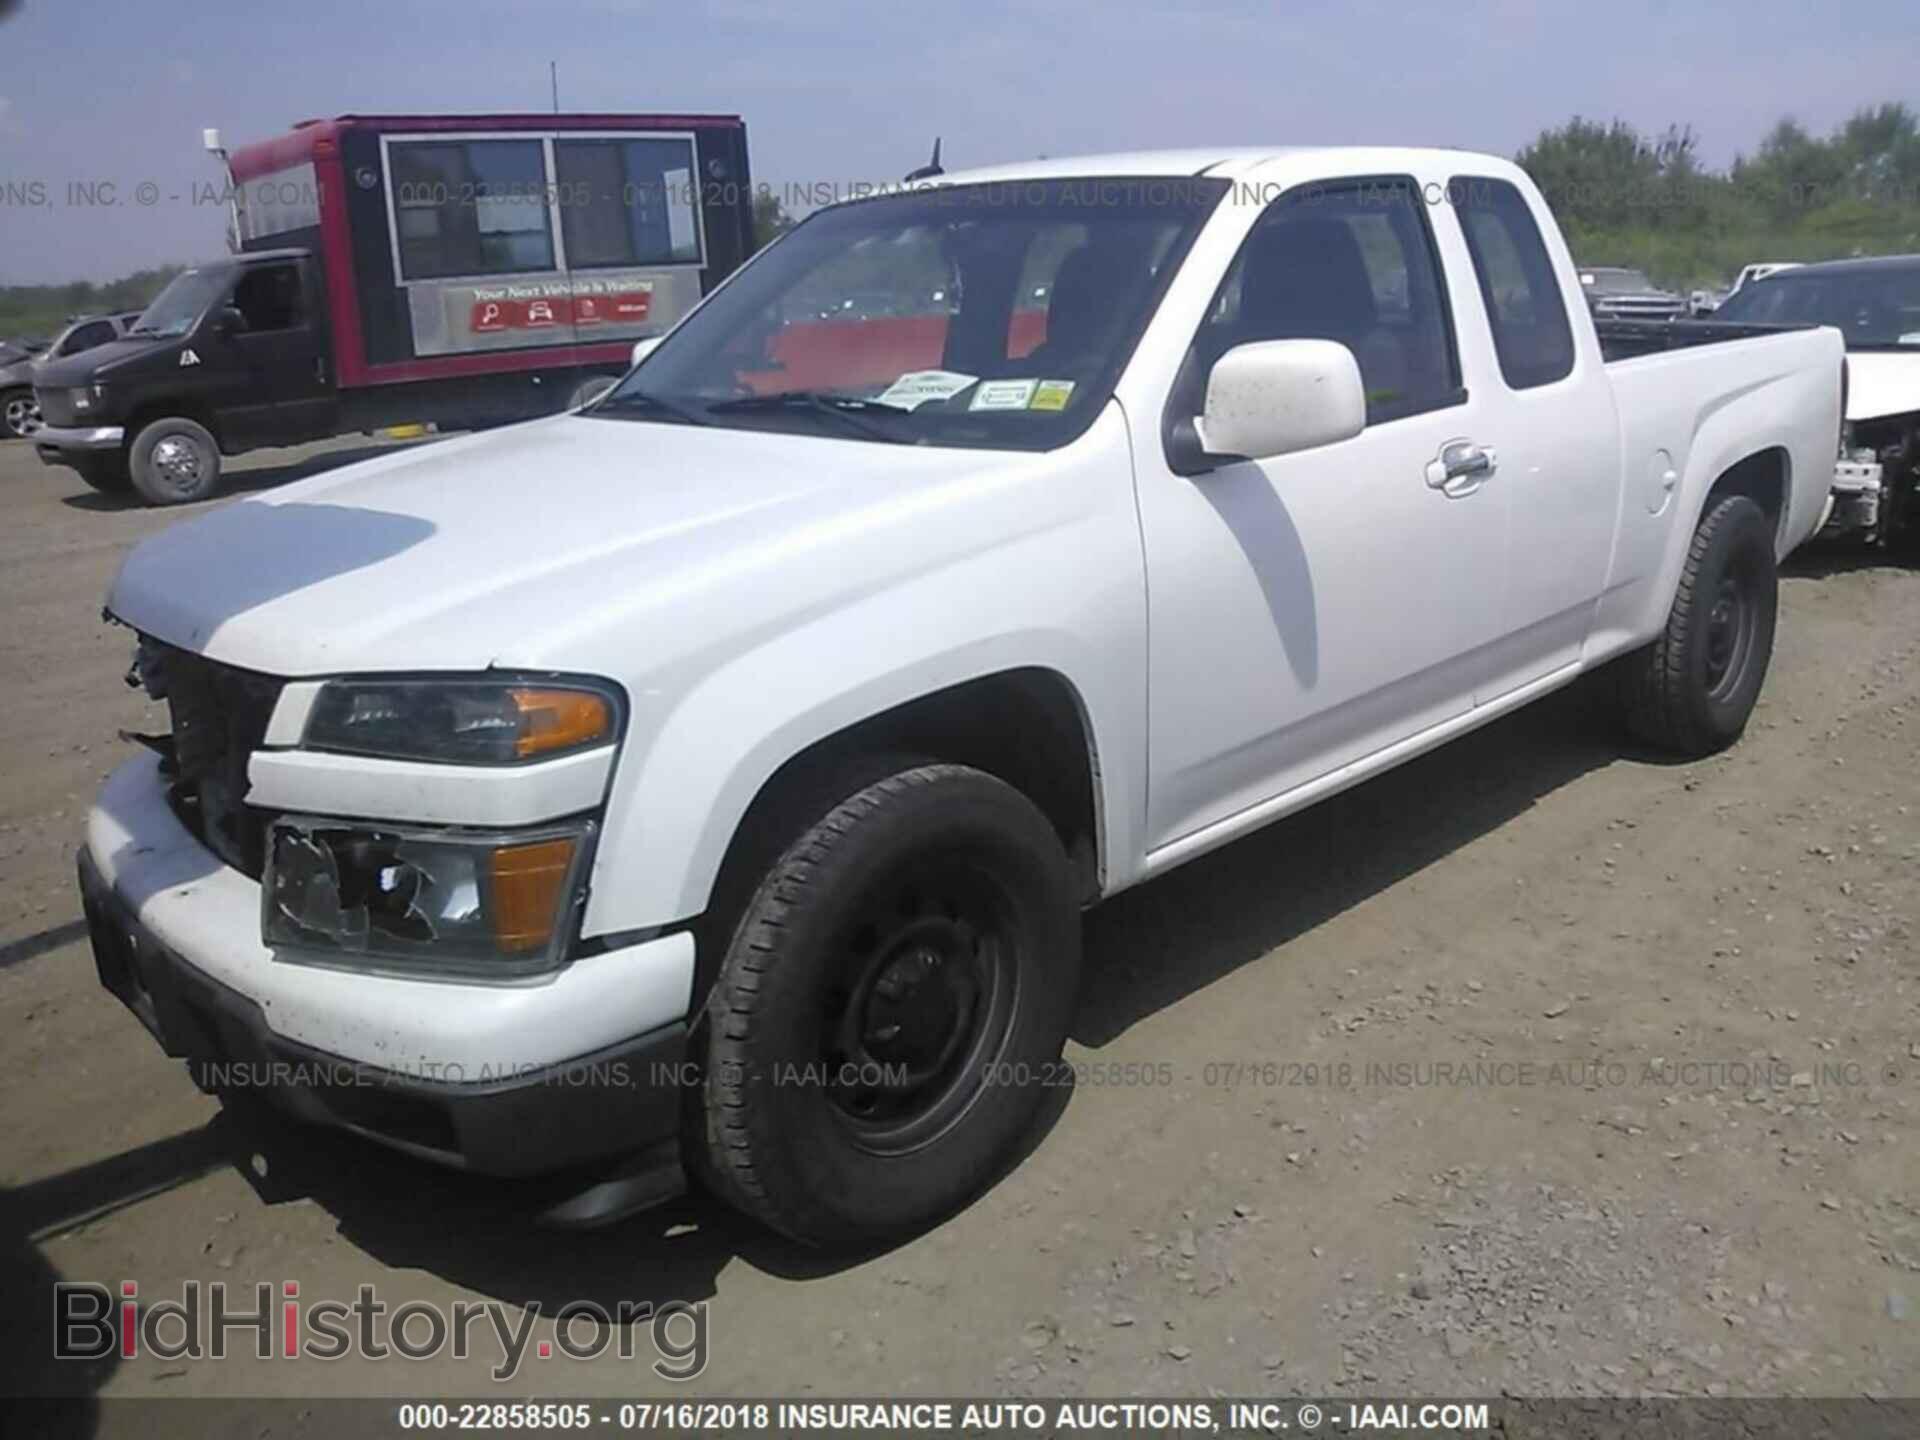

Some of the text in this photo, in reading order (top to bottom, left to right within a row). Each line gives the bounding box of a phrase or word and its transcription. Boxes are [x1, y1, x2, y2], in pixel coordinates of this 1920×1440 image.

[473, 288, 506, 300] Your
[507, 285, 541, 298] Next
[543, 281, 591, 297] Vehicle
[606, 279, 654, 293] Waiting
